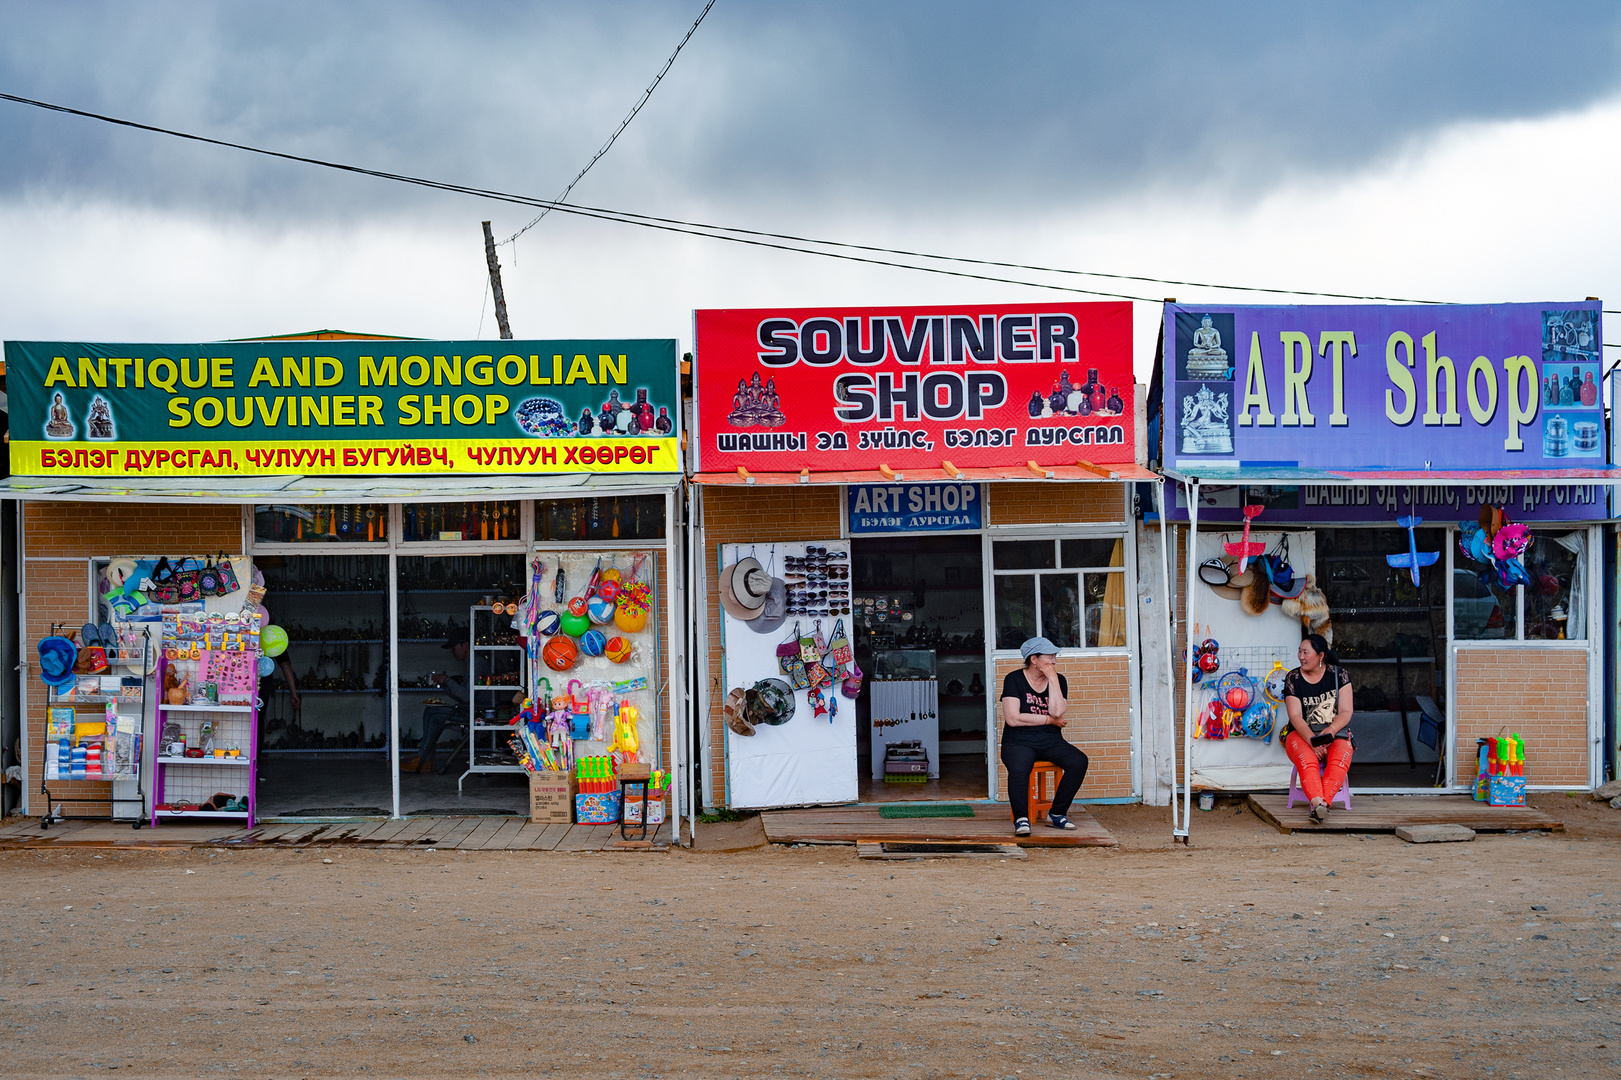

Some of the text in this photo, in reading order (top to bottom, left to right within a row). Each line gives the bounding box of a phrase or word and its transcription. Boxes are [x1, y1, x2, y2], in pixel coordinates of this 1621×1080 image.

[757, 313, 1080, 367] SOUVINER
[44, 354, 629, 394] ANTIQUE AND MONGOLIAN
[1238, 329, 1540, 451] ART Shop
[167, 394, 511, 428] SOUVINER SHOP
[833, 370, 1009, 423] SHOP
[716, 431, 808, 453] ШАШНЫ
[815, 430, 848, 451] ЭД
[944, 427, 1018, 448] БЭЛЭГ
[1024, 425, 1126, 447] ДУРСГАЛ
[41, 444, 660, 471] БЭЛЭГ ДУРСГАЛ, ЧУЛУУН БУГУЙВЧ, ЧУЛУУН ХӨӨРӨГ
[854, 485, 976, 513] ART SHOP
[861, 515, 971, 527] БЭЛЭГ ДУРСГАЛ
